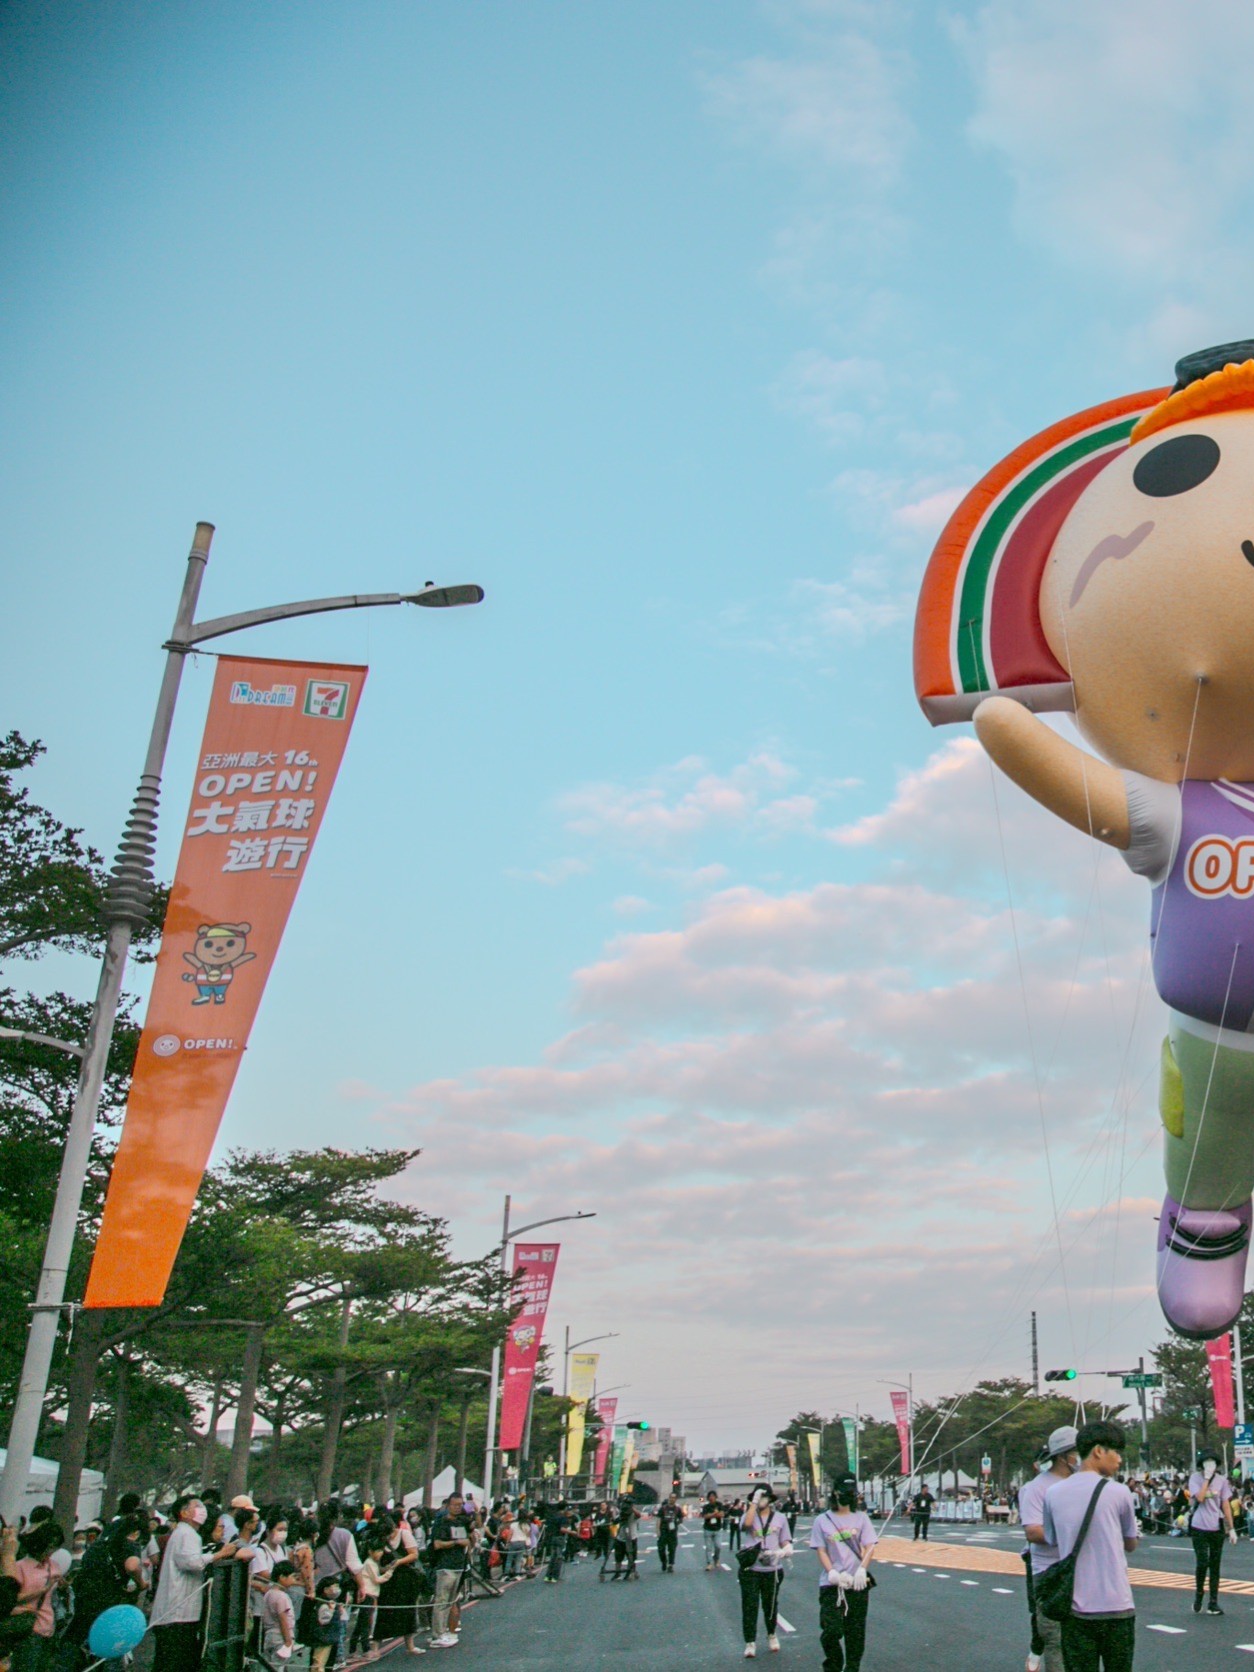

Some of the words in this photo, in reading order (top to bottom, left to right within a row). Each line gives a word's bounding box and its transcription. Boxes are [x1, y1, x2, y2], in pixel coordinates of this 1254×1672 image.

[201, 751, 279, 770] 亞洲最大
[198, 770, 317, 797] OPEN!
[187, 798, 315, 837] 大氣球
[222, 836, 309, 872] 遊行
[184, 1039, 233, 1050] OPEN!
[1234, 1425, 1245, 1438] P
